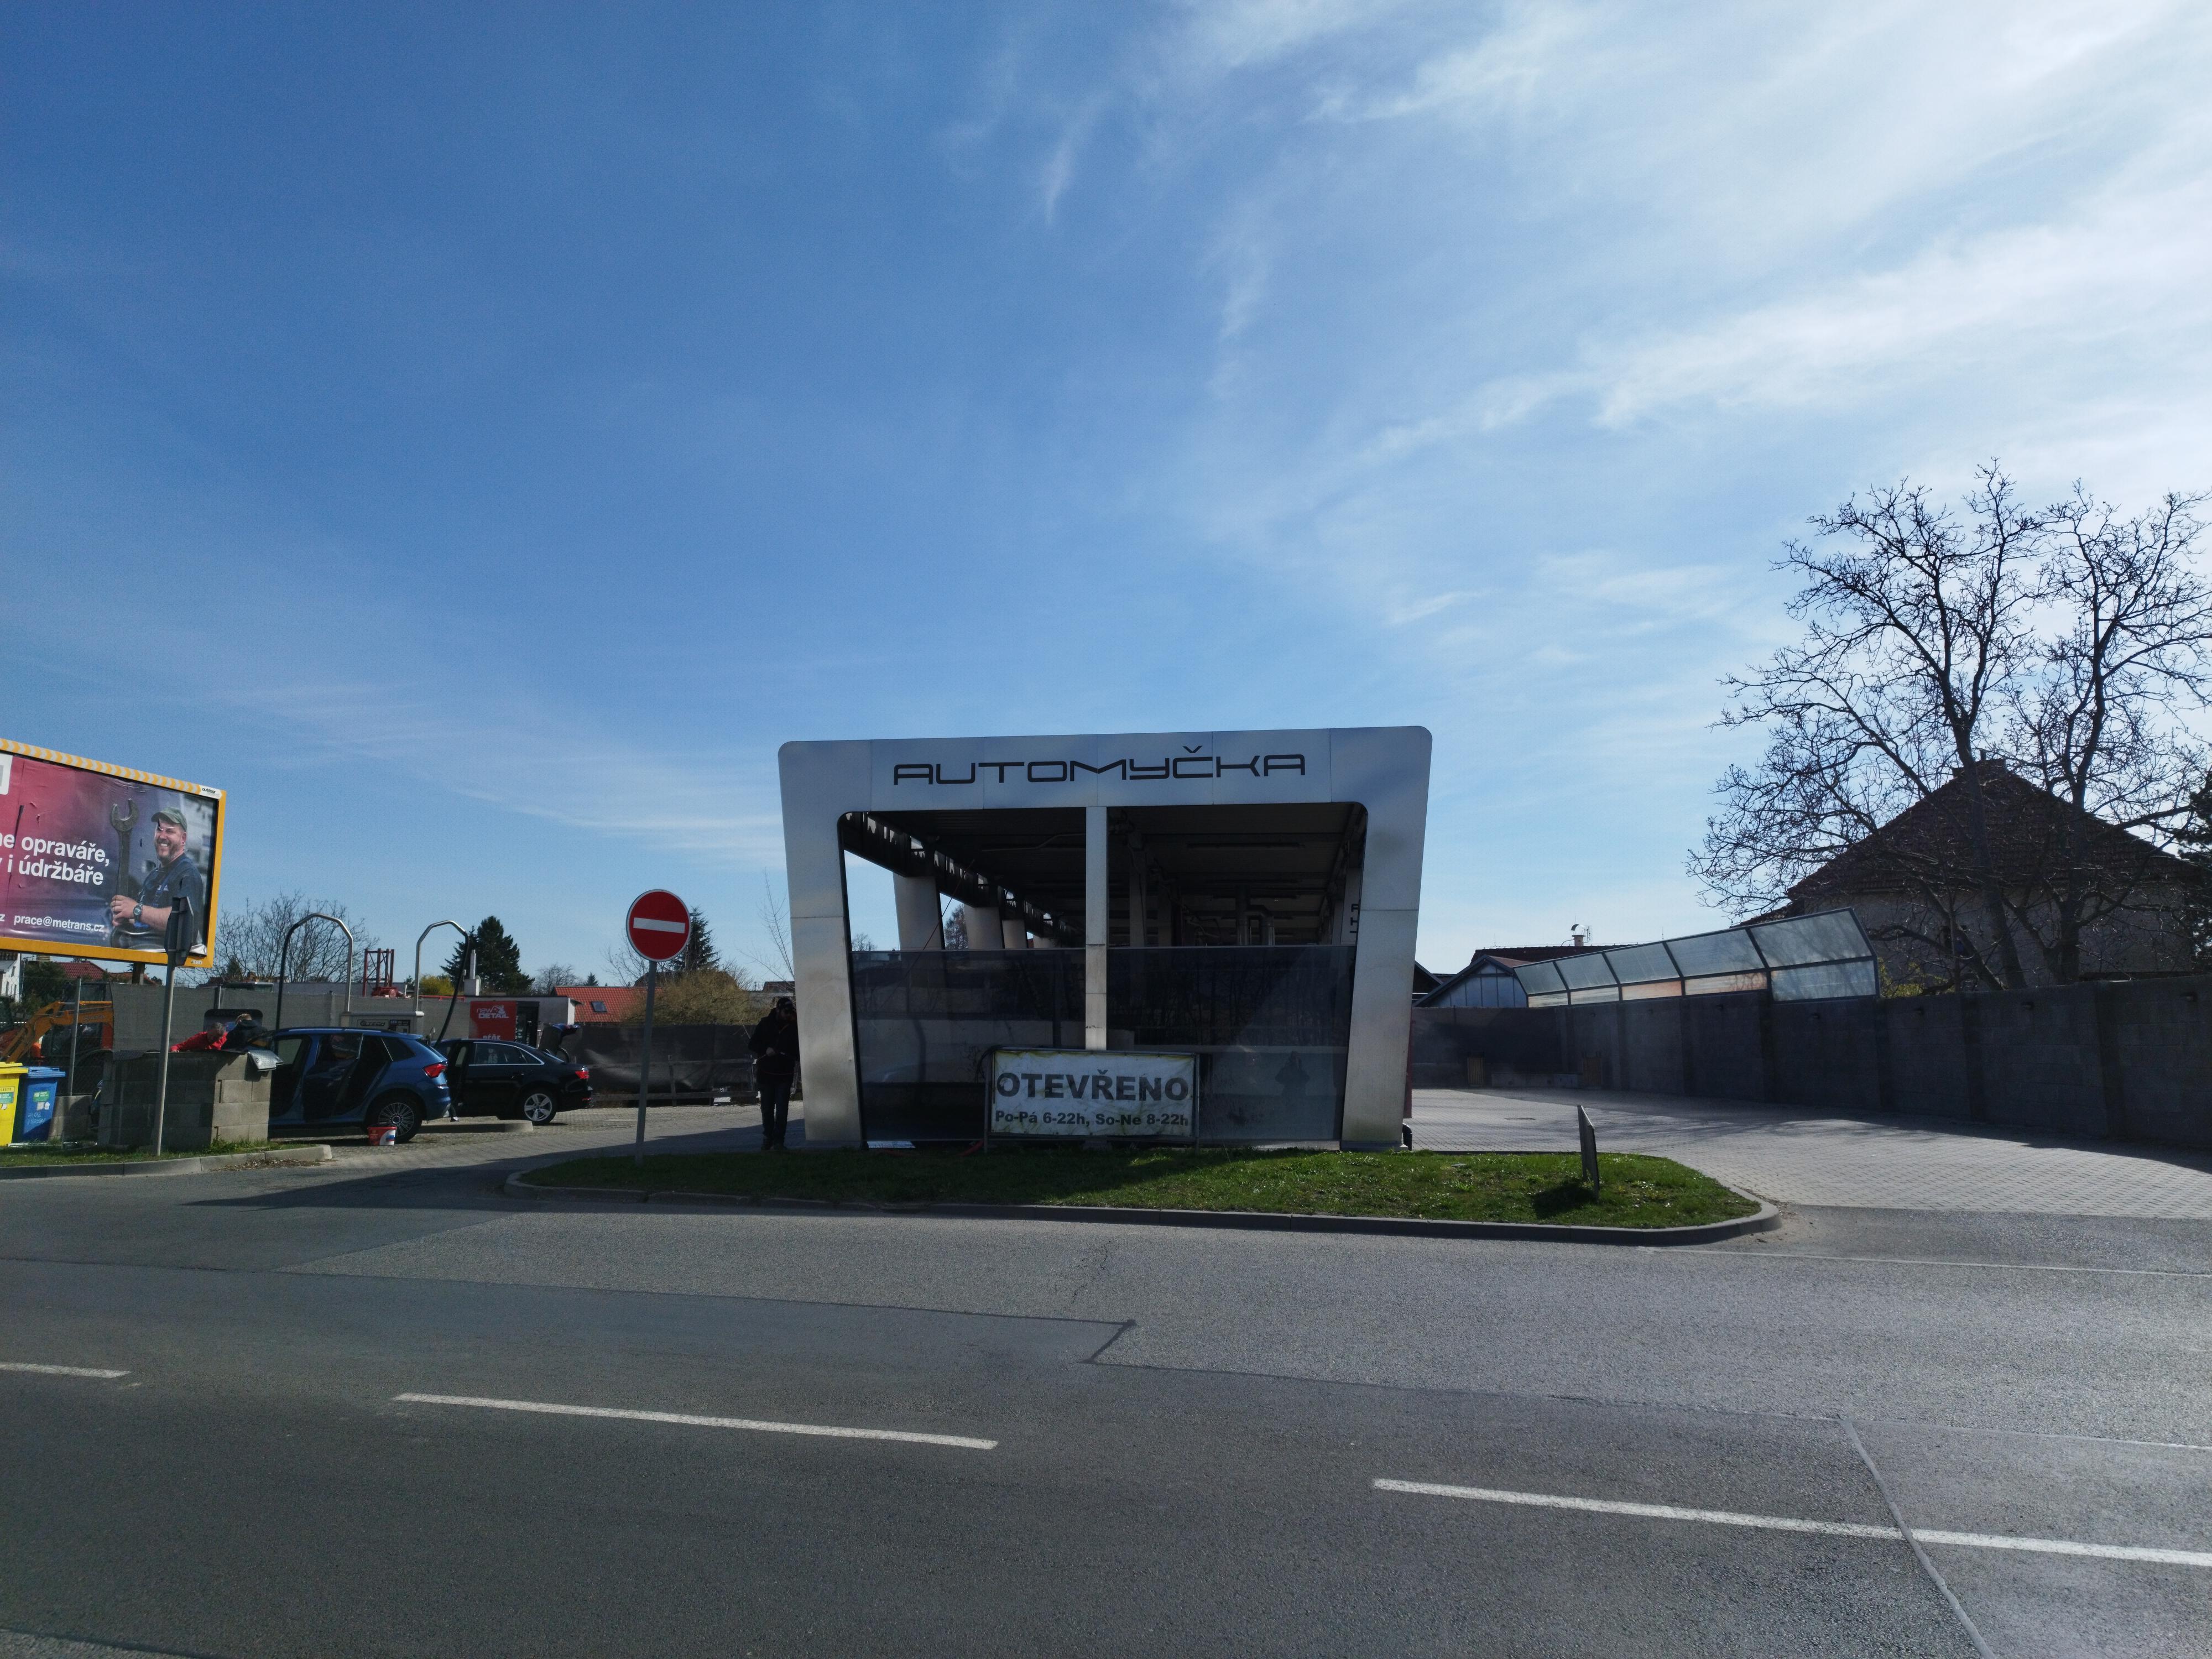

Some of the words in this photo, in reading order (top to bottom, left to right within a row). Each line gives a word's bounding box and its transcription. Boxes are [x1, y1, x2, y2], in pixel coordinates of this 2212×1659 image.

[894, 745, 1306, 785] AUTOMYČKA
[21, 837, 109, 867] opraváře,
[8, 854, 13, 873] i
[19, 855, 103, 885] údržbáře
[14, 915, 105, 932] prace@metrans.cz
[997, 1069, 1189, 1102] OTEVŘENO
[996, 1110, 1037, 1124] Po-Pá
[1043, 1112, 1089, 1127] 6-22h,
[1095, 1113, 1141, 1125] So-Ne
[1146, 1114, 1188, 1126] 8-22h
